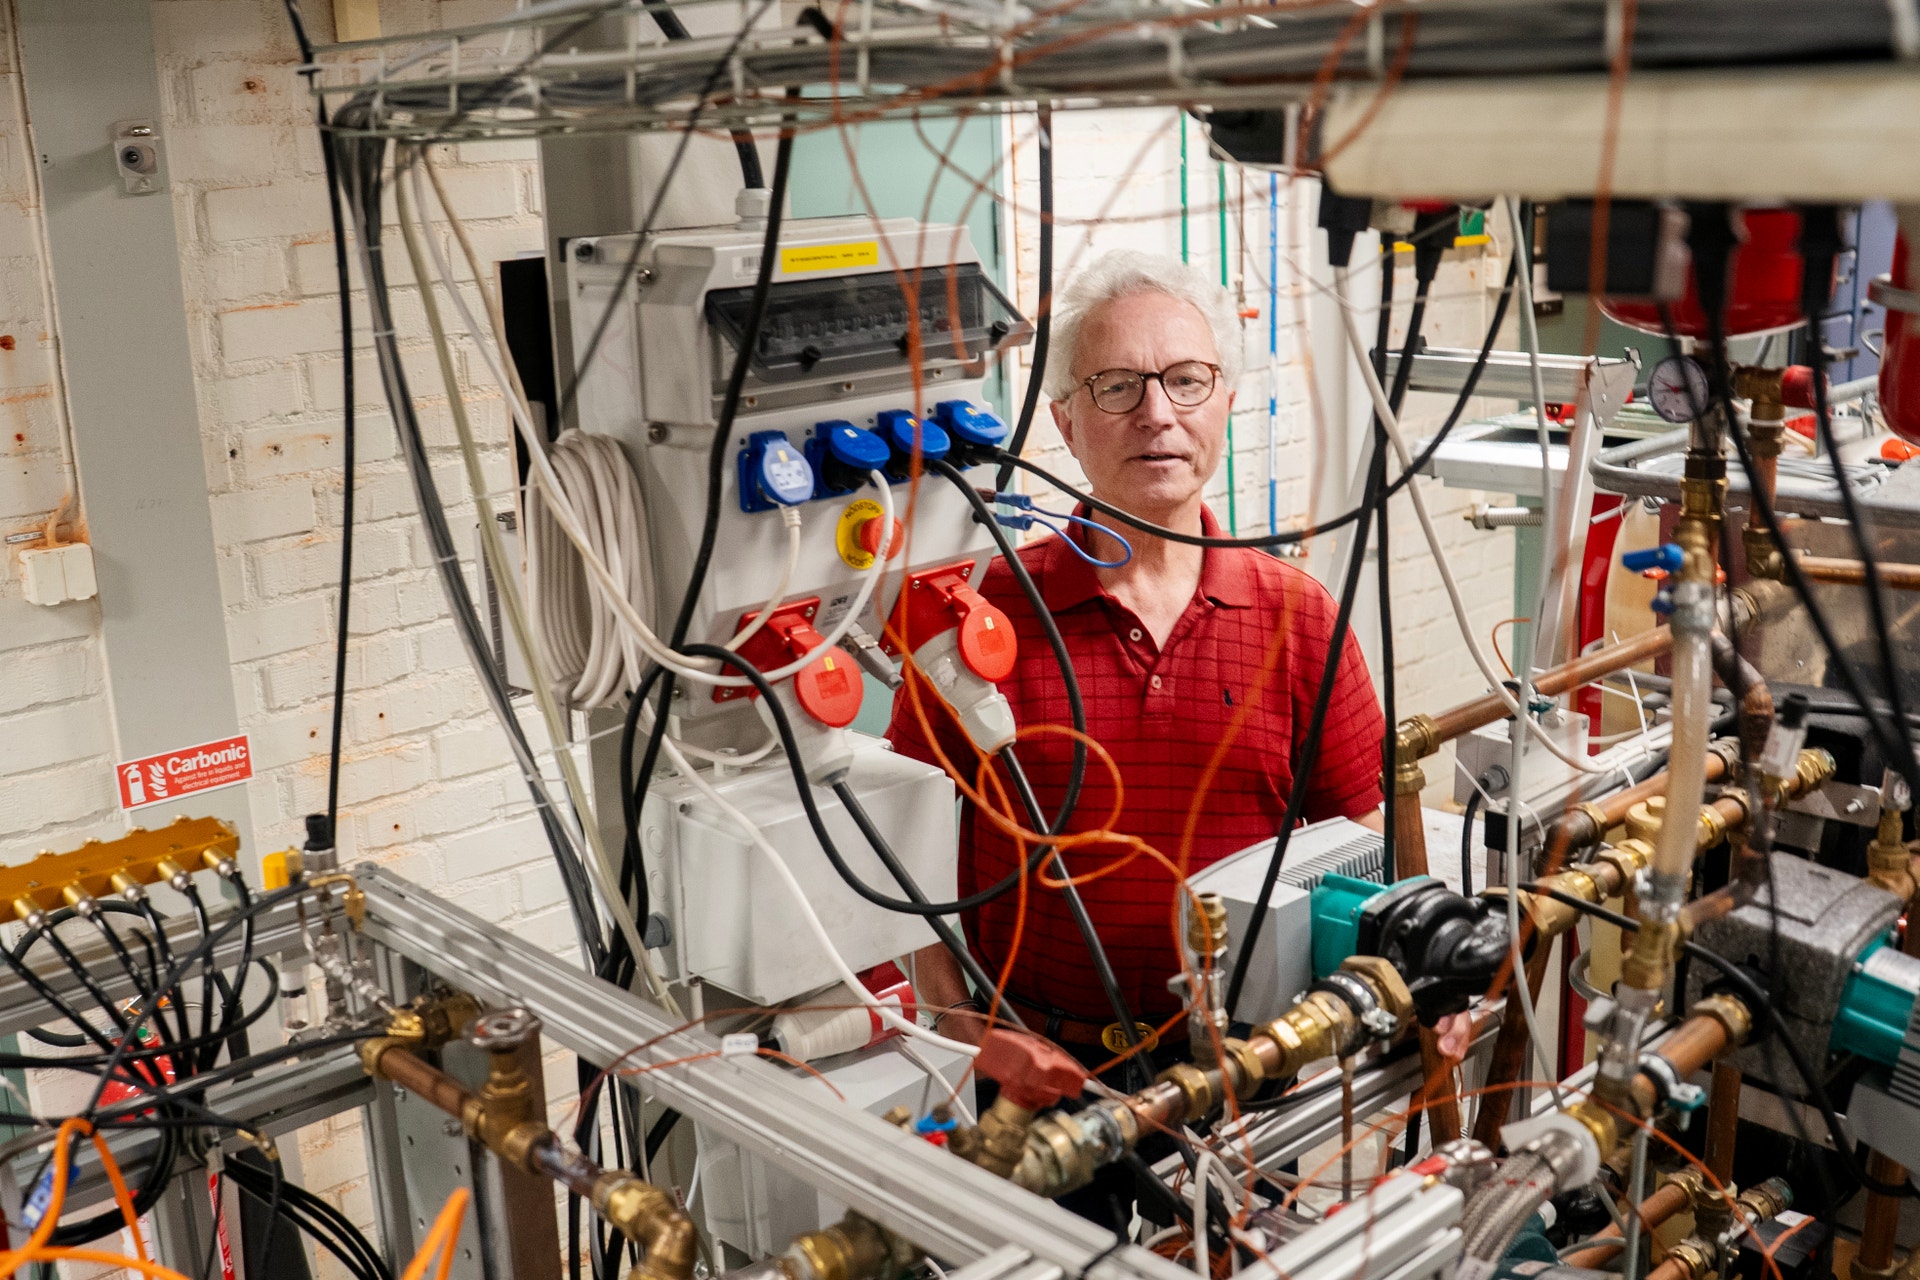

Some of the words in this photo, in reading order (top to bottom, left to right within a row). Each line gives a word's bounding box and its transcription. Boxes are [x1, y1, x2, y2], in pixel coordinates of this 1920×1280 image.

[167, 743, 247, 775] Carbonic
[174, 773, 197, 784] Against
[197, 770, 207, 778] fire
[215, 765, 234, 774] liquids
[234, 761, 246, 770] and
[182, 778, 210, 790] electrical
[210, 771, 241, 783] equipment
